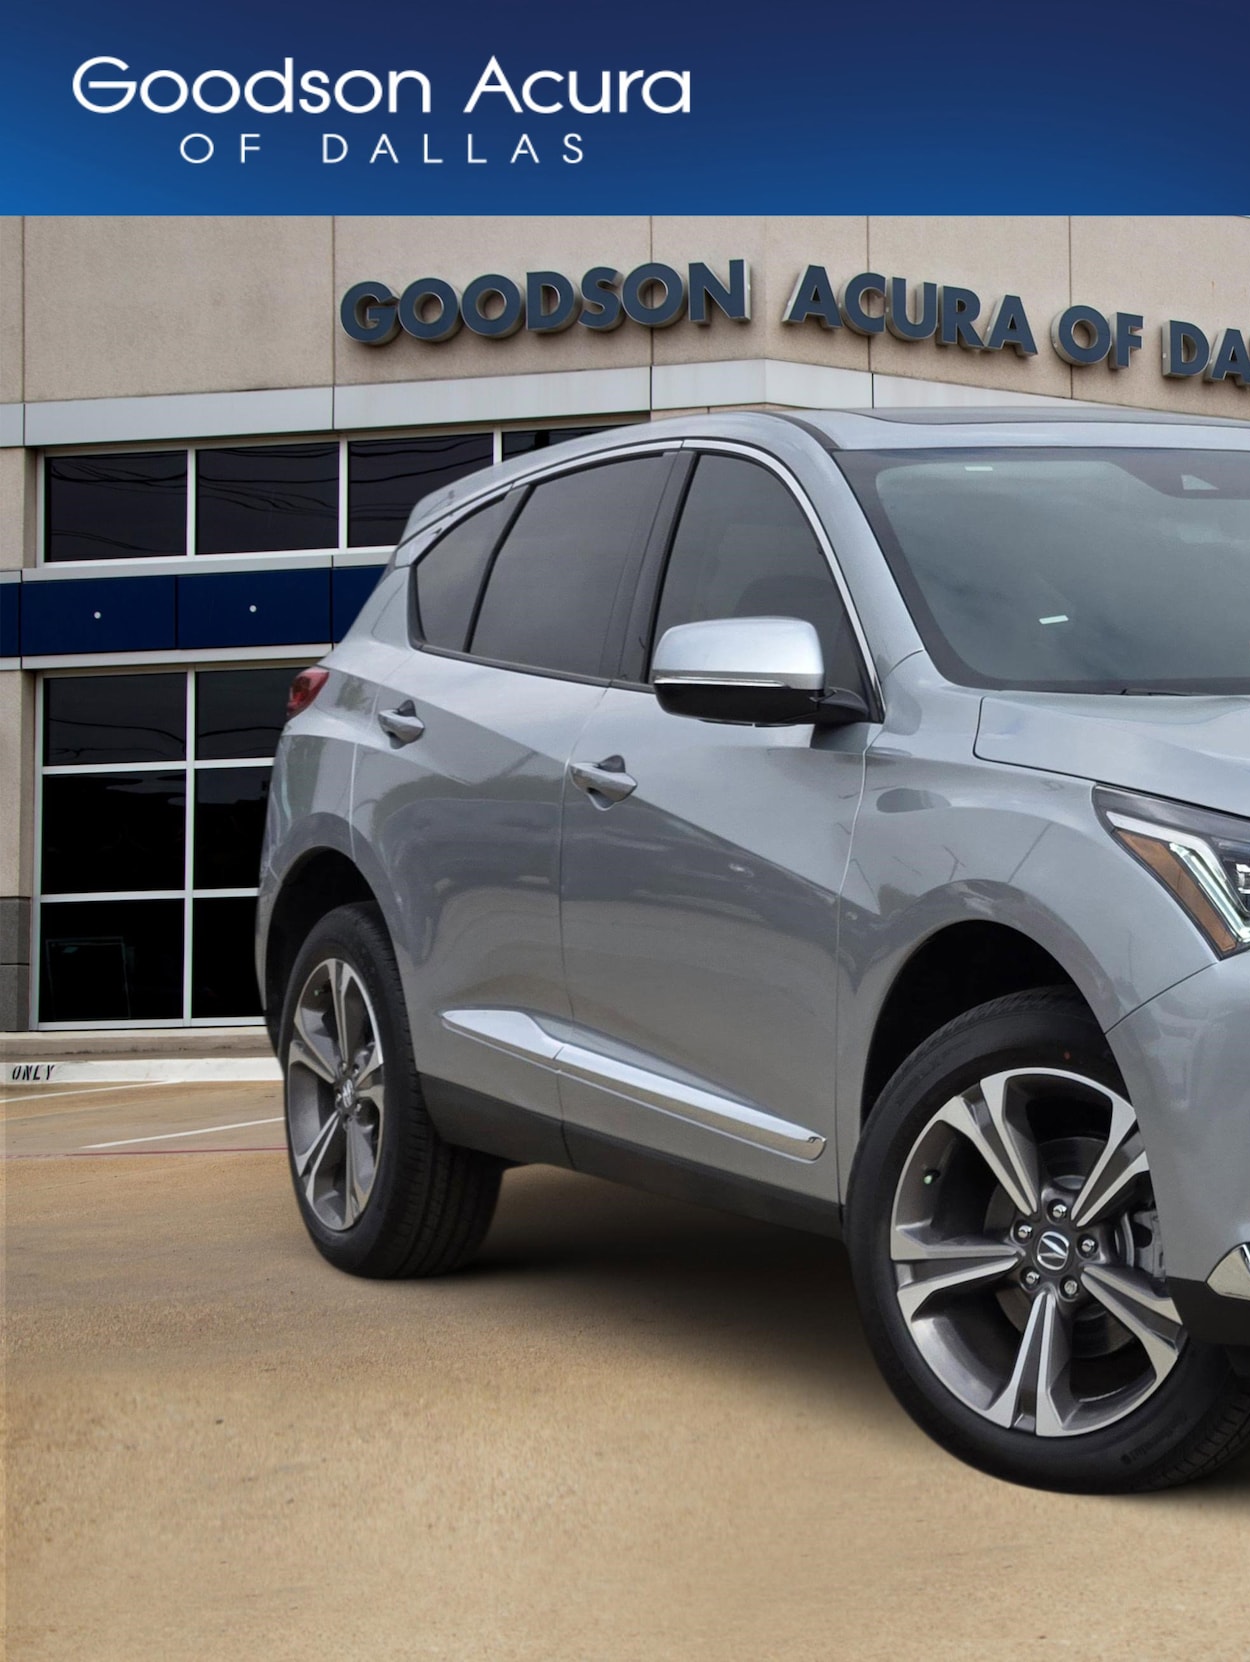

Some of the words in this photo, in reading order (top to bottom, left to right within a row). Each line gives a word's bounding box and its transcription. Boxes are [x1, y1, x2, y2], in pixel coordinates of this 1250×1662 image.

[340, 258, 752, 347] GOODSON
[782, 263, 1038, 357] ACURA
[1051, 303, 1144, 370] OF
[12, 1064, 55, 1081] ONLY
